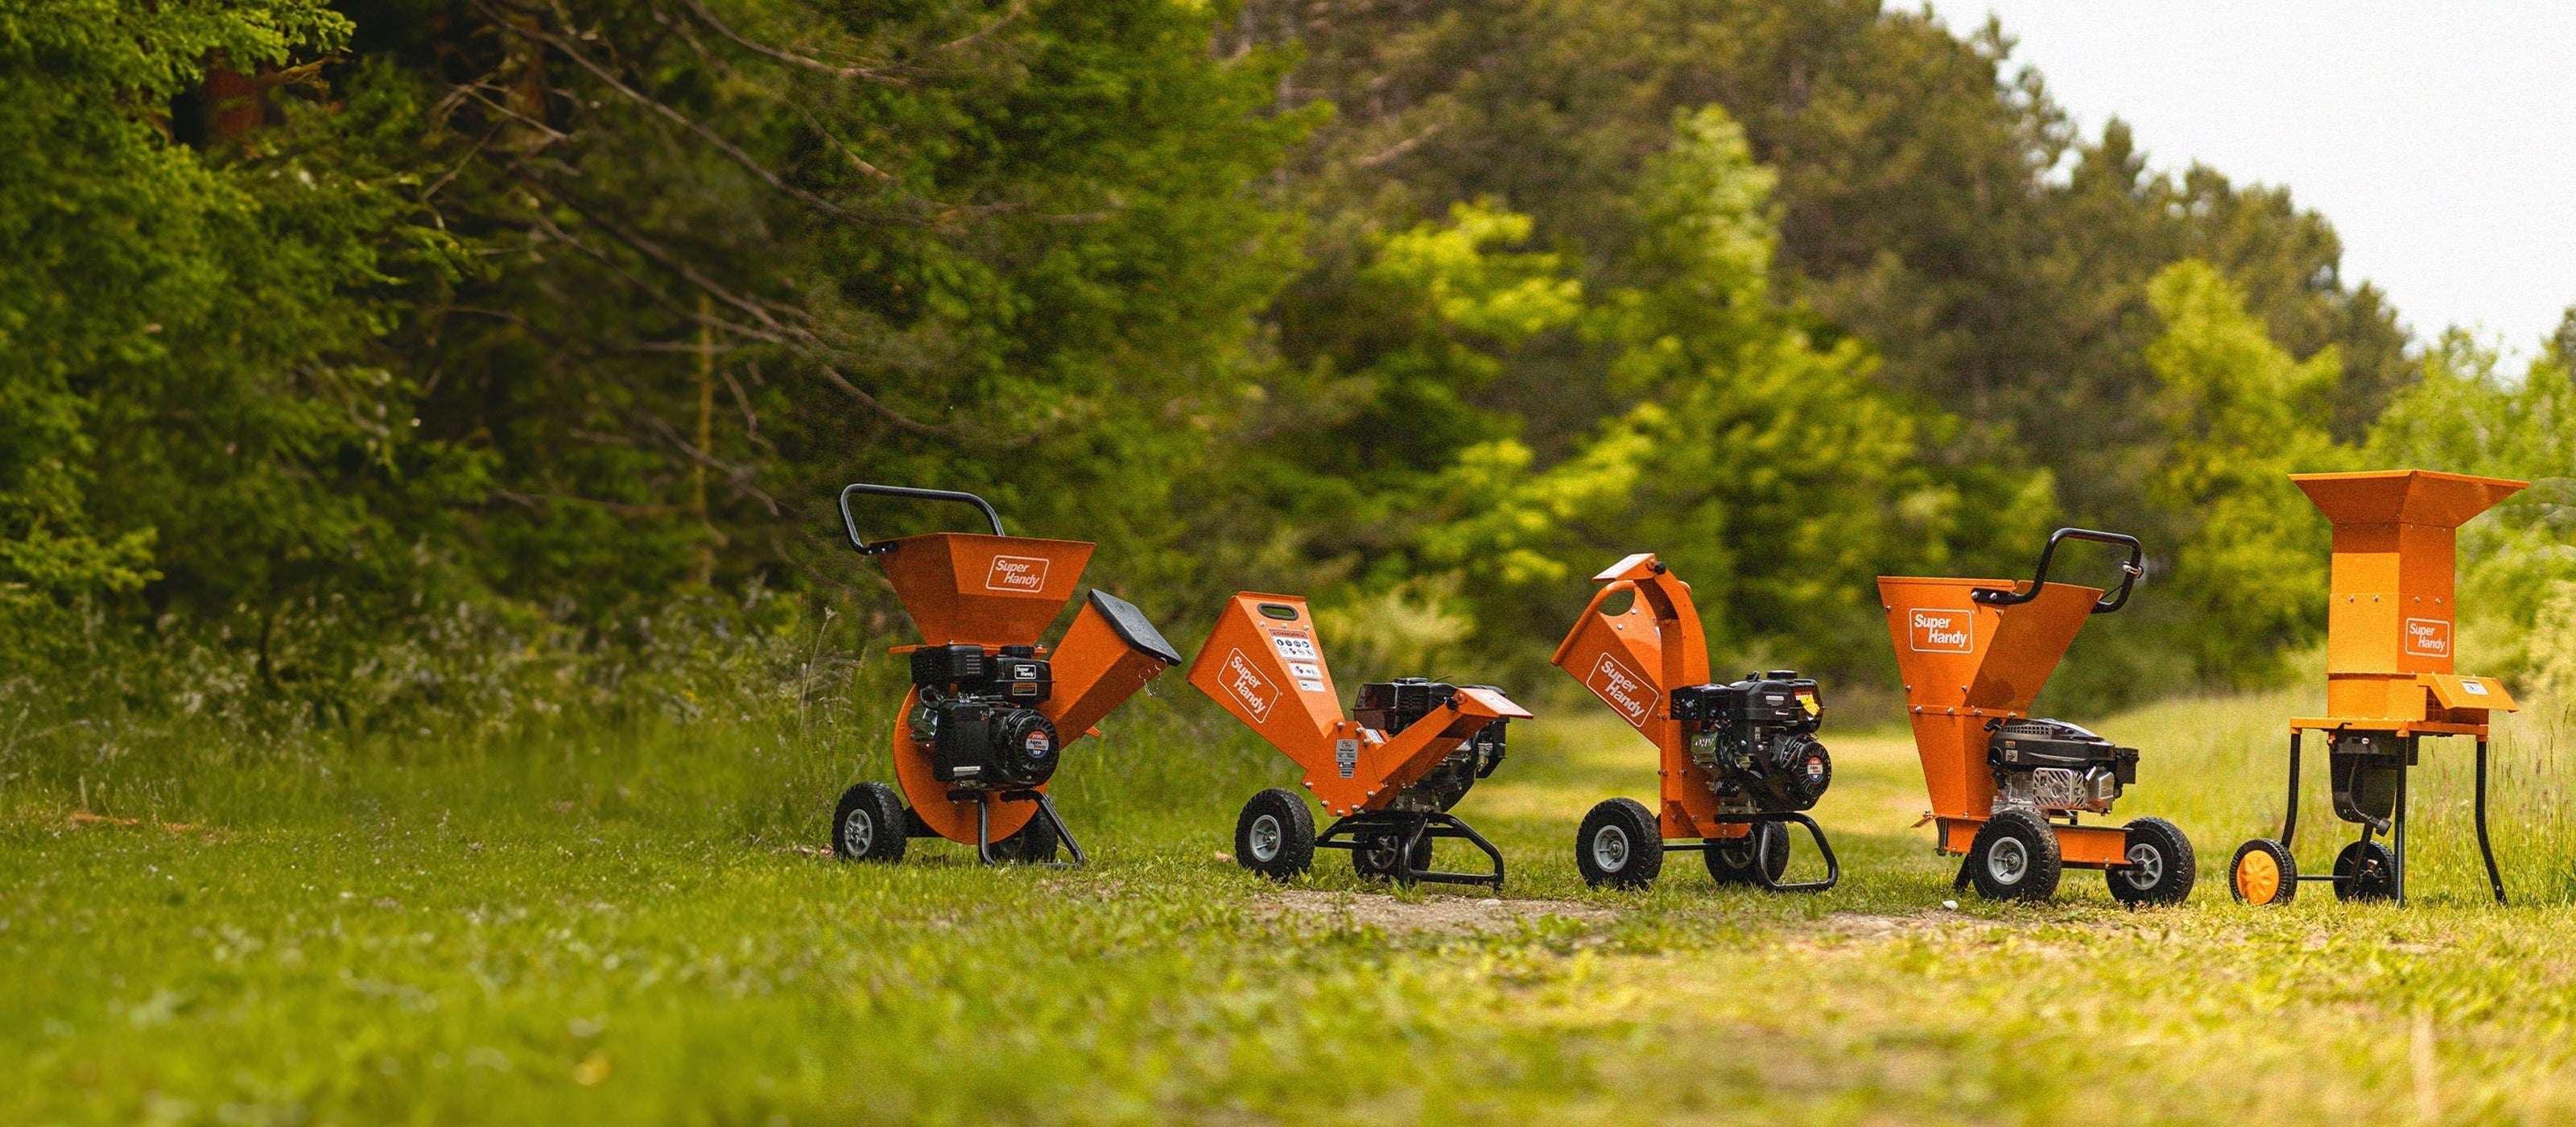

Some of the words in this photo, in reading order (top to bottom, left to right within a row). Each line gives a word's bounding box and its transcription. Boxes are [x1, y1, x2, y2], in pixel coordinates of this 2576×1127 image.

[996, 559, 1030, 573] Super
[1004, 572, 1040, 588] Handy
[1914, 613, 1951, 629] Super
[2409, 623, 2435, 636] Super
[1928, 627, 1968, 648] Handy
[2418, 635, 2446, 652] Handy
[1231, 656, 1261, 689] Super
[1601, 661, 1638, 692] Super
[1233, 678, 1266, 714] Handy
[1605, 681, 1645, 717] Handy
